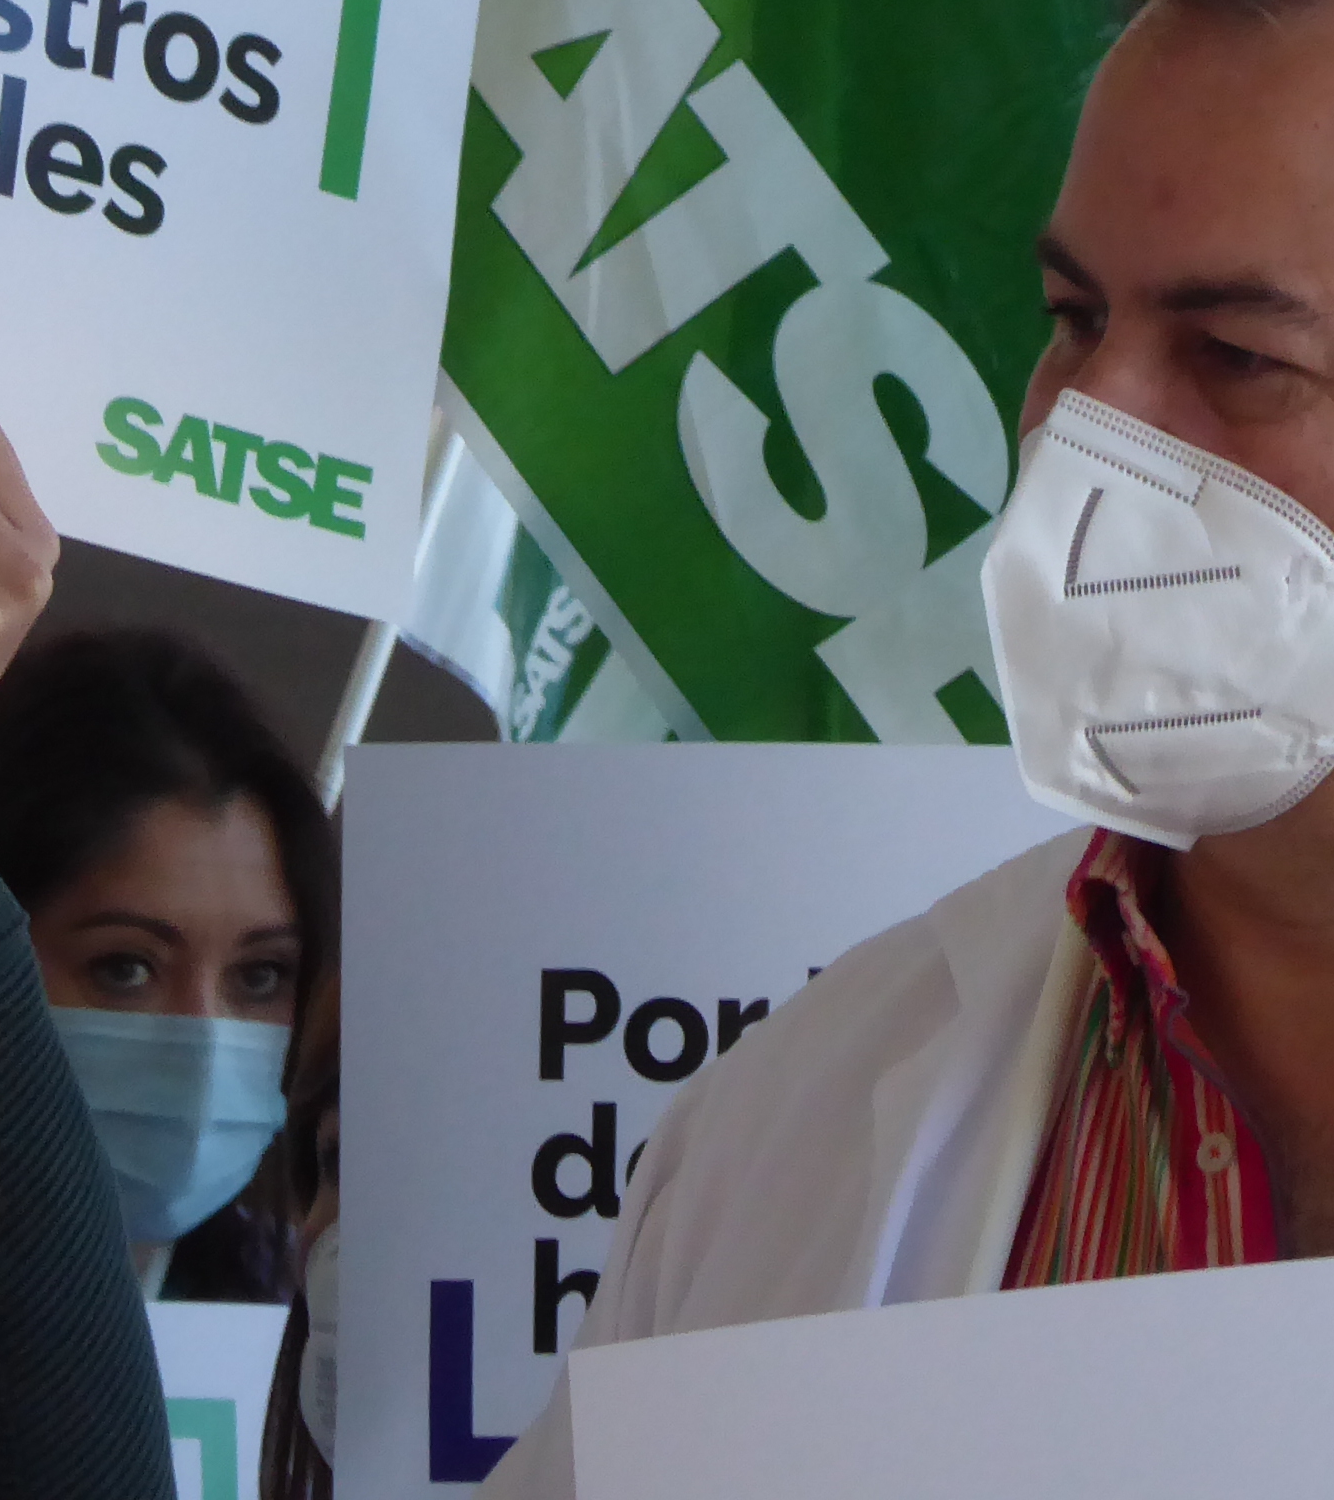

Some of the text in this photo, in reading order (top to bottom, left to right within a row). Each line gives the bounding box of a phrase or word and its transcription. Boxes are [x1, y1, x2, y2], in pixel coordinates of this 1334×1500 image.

[94, 393, 374, 541] SATSE
[539, 967, 771, 1083] Por
[531, 1101, 648, 1219] d
